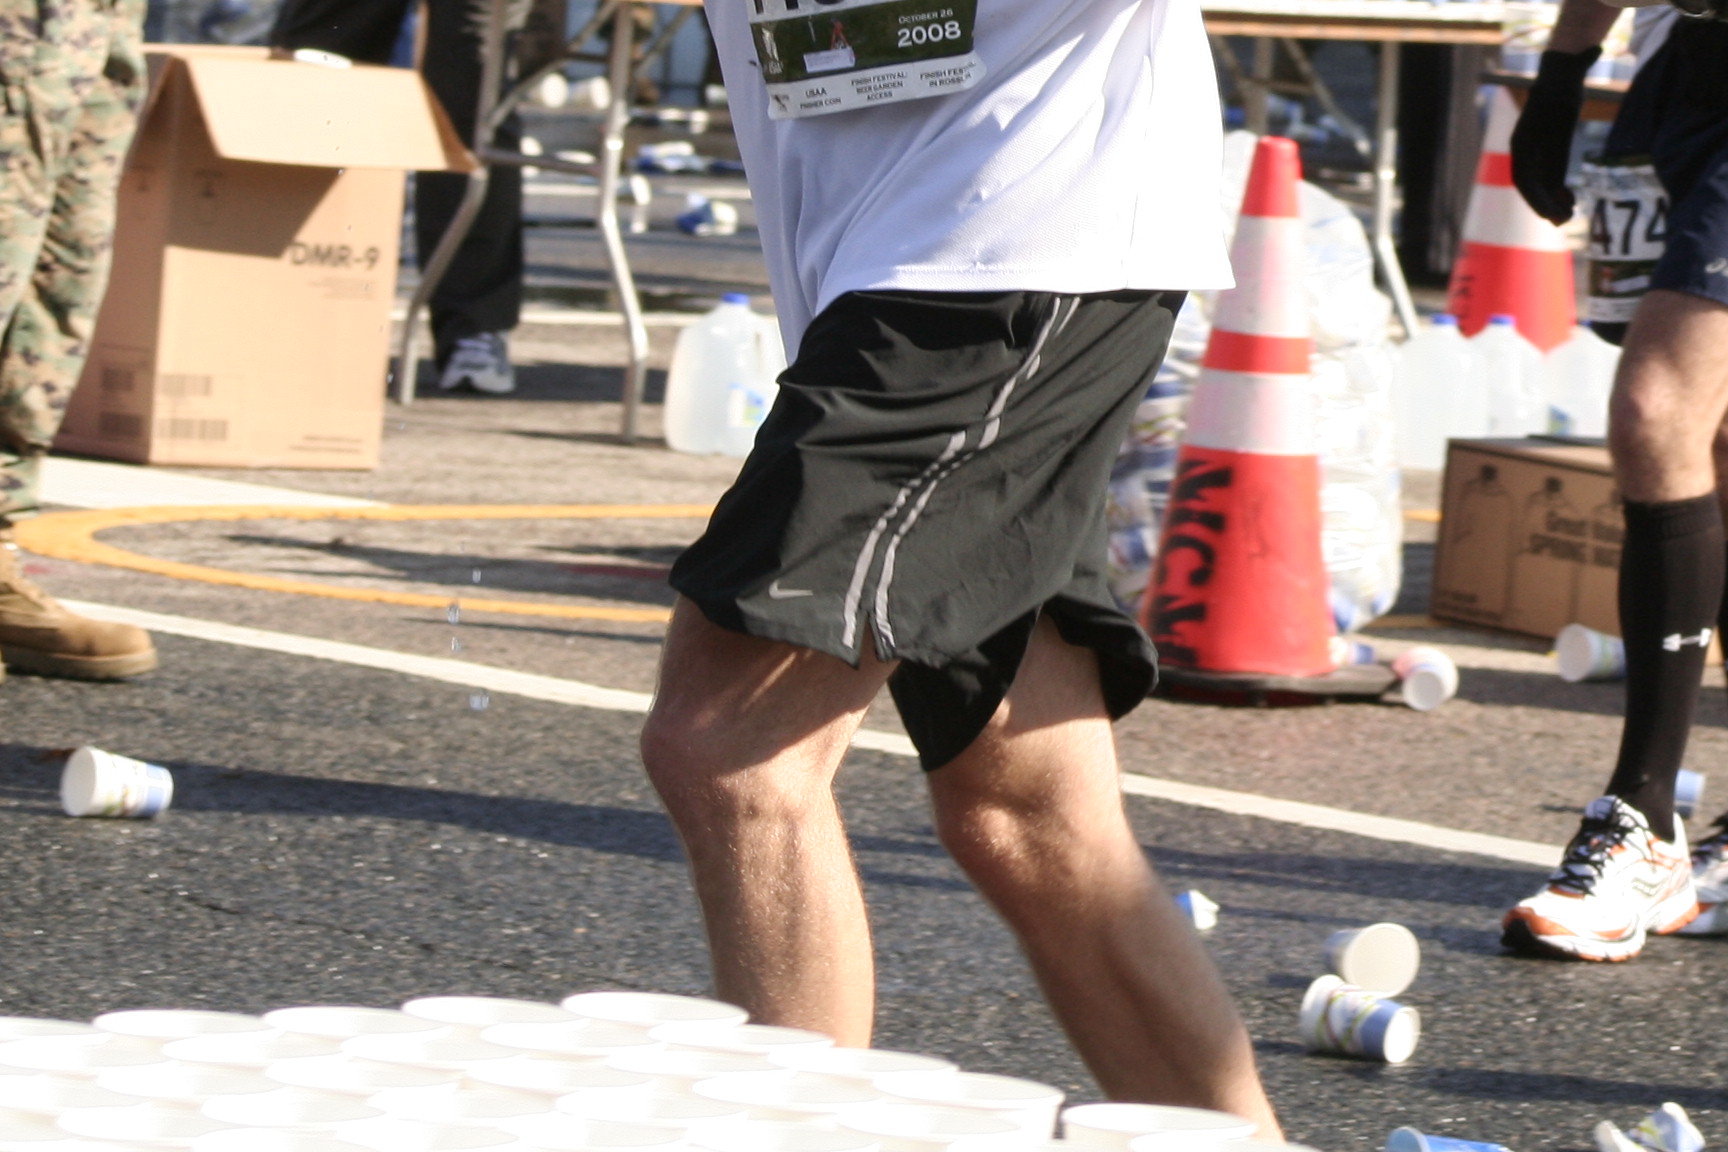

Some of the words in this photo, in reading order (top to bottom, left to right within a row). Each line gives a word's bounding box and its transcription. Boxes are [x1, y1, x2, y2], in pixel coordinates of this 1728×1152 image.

[940, 8, 953, 18] 26
[897, 20, 961, 48] 2008
[867, 91, 893, 101] ACCESS
[291, 242, 380, 270] DMR-9
[1150, 460, 1233, 668] MCM
